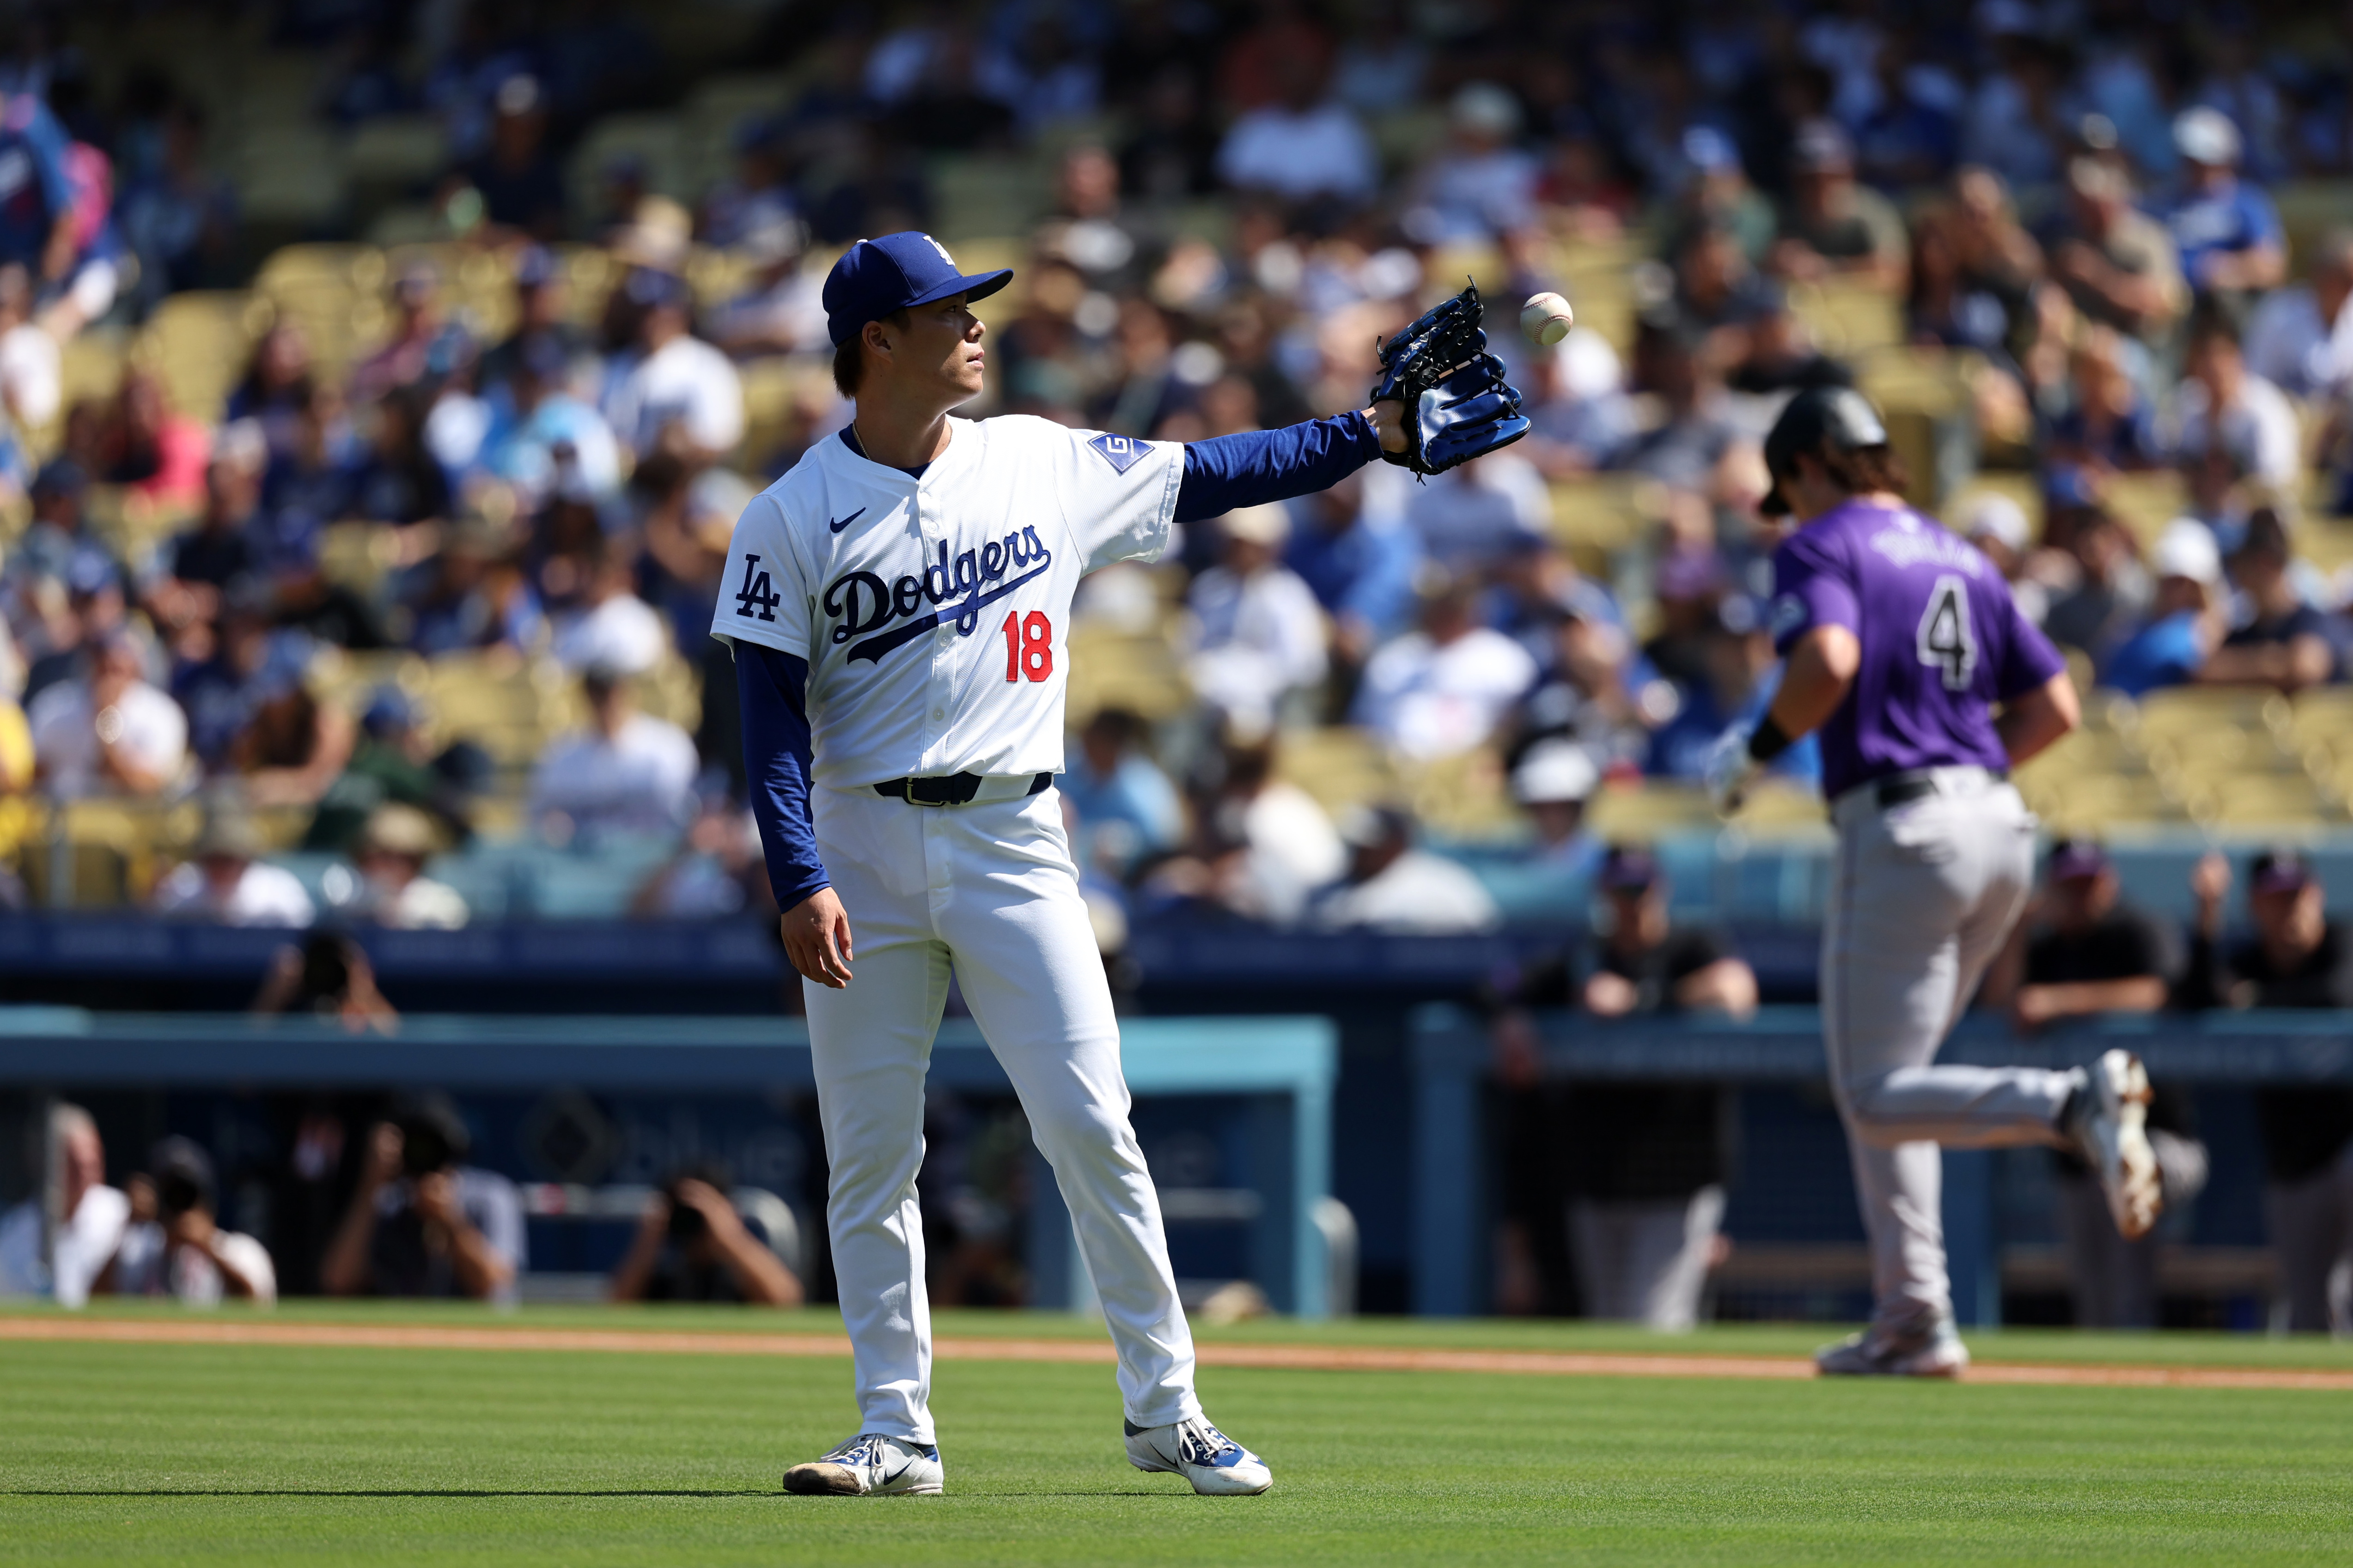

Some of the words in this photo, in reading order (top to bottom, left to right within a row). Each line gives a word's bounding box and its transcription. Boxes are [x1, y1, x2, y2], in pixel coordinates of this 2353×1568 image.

[1106, 437, 1128, 454] G
[736, 553, 780, 622] LA
[823, 524, 1051, 644] Dodgers
[1002, 610, 1053, 682] 18
[1916, 574, 1979, 691] 4
